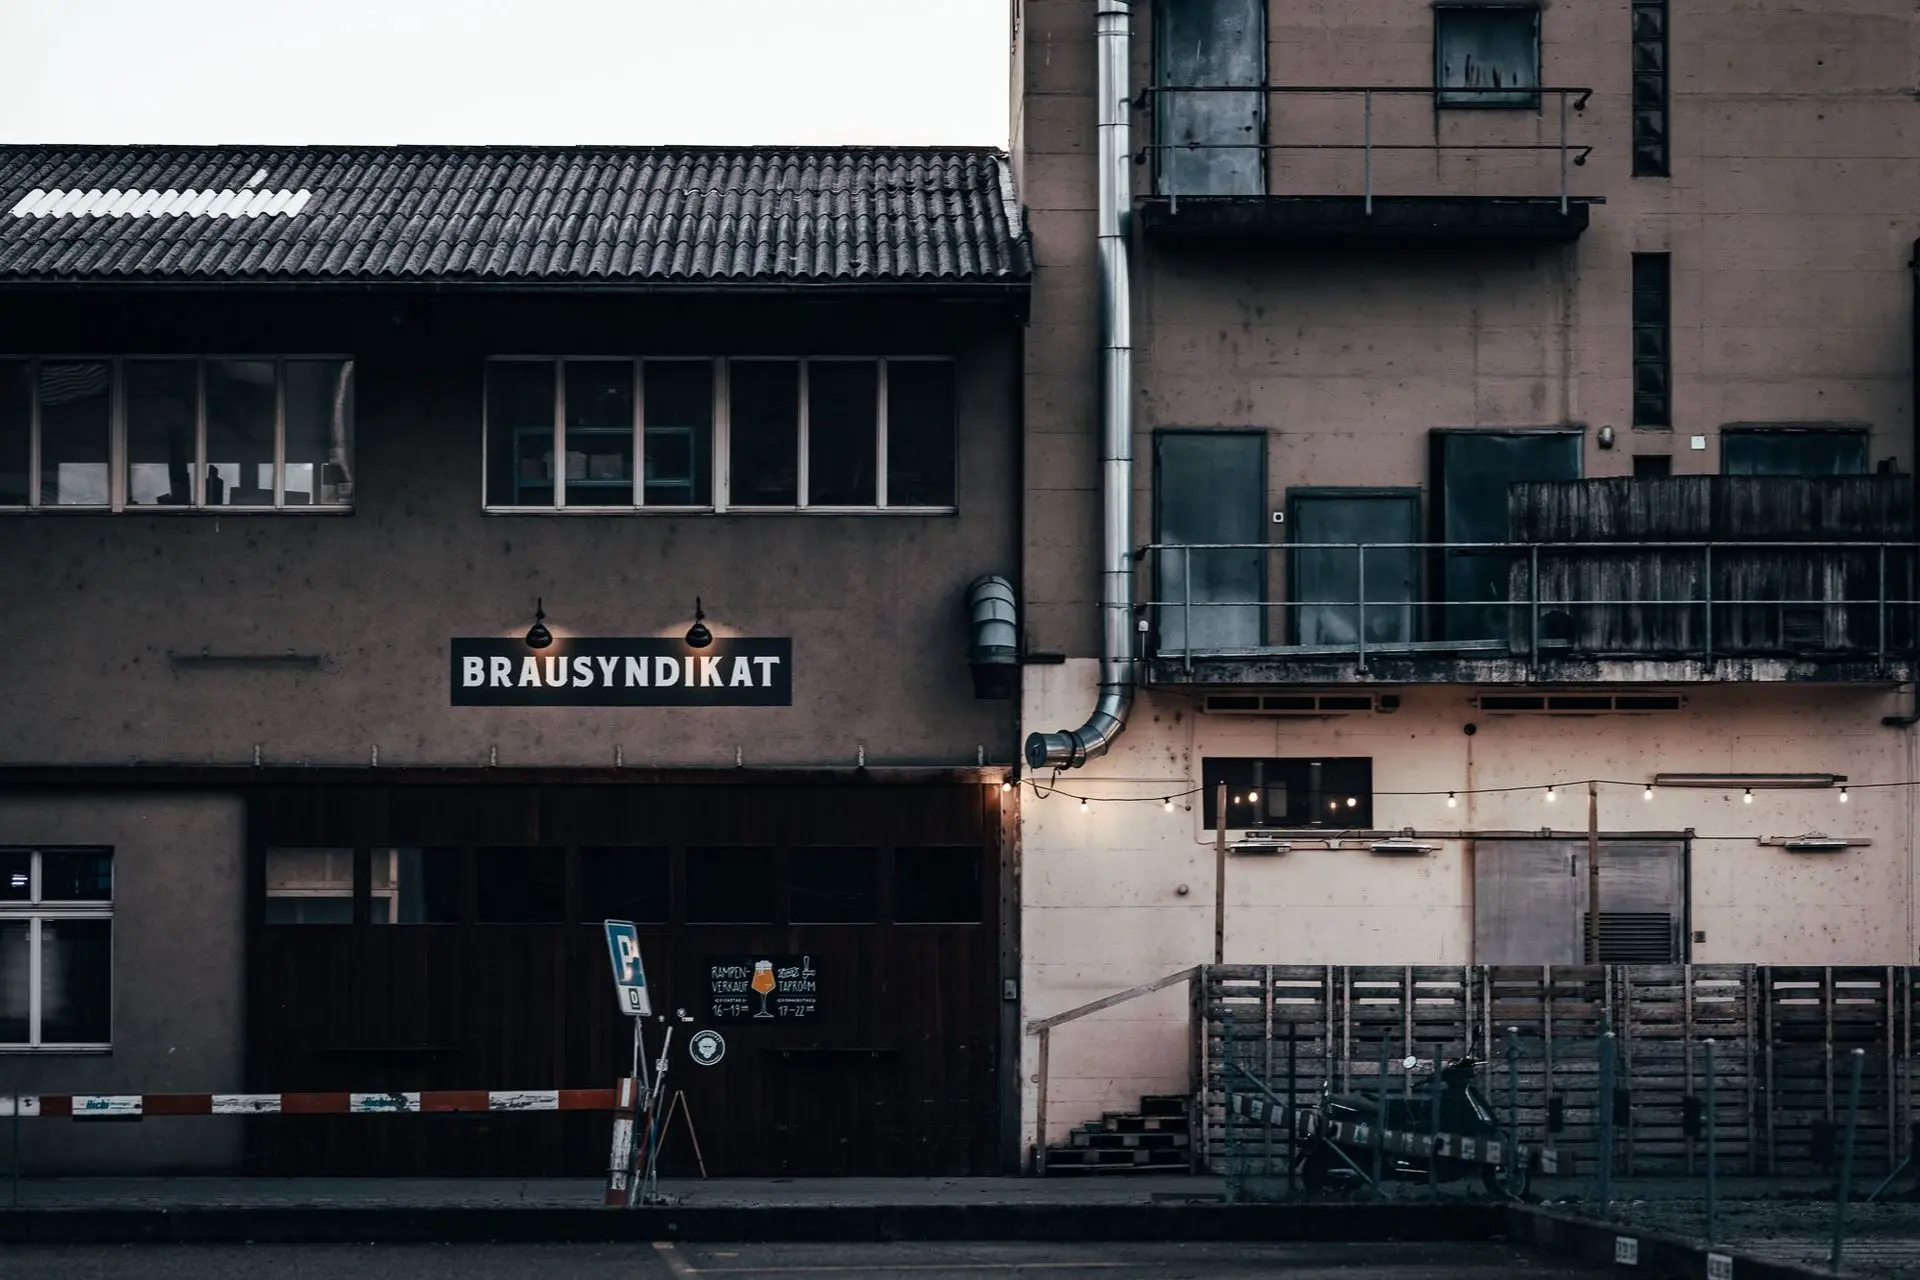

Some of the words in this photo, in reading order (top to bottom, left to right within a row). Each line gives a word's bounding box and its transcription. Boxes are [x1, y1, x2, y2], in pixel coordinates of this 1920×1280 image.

[462, 655, 780, 688] BRAUSYNDIKAT
[711, 966, 751, 979] RAMPEN-
[711, 981, 749, 993] VERKAUF
